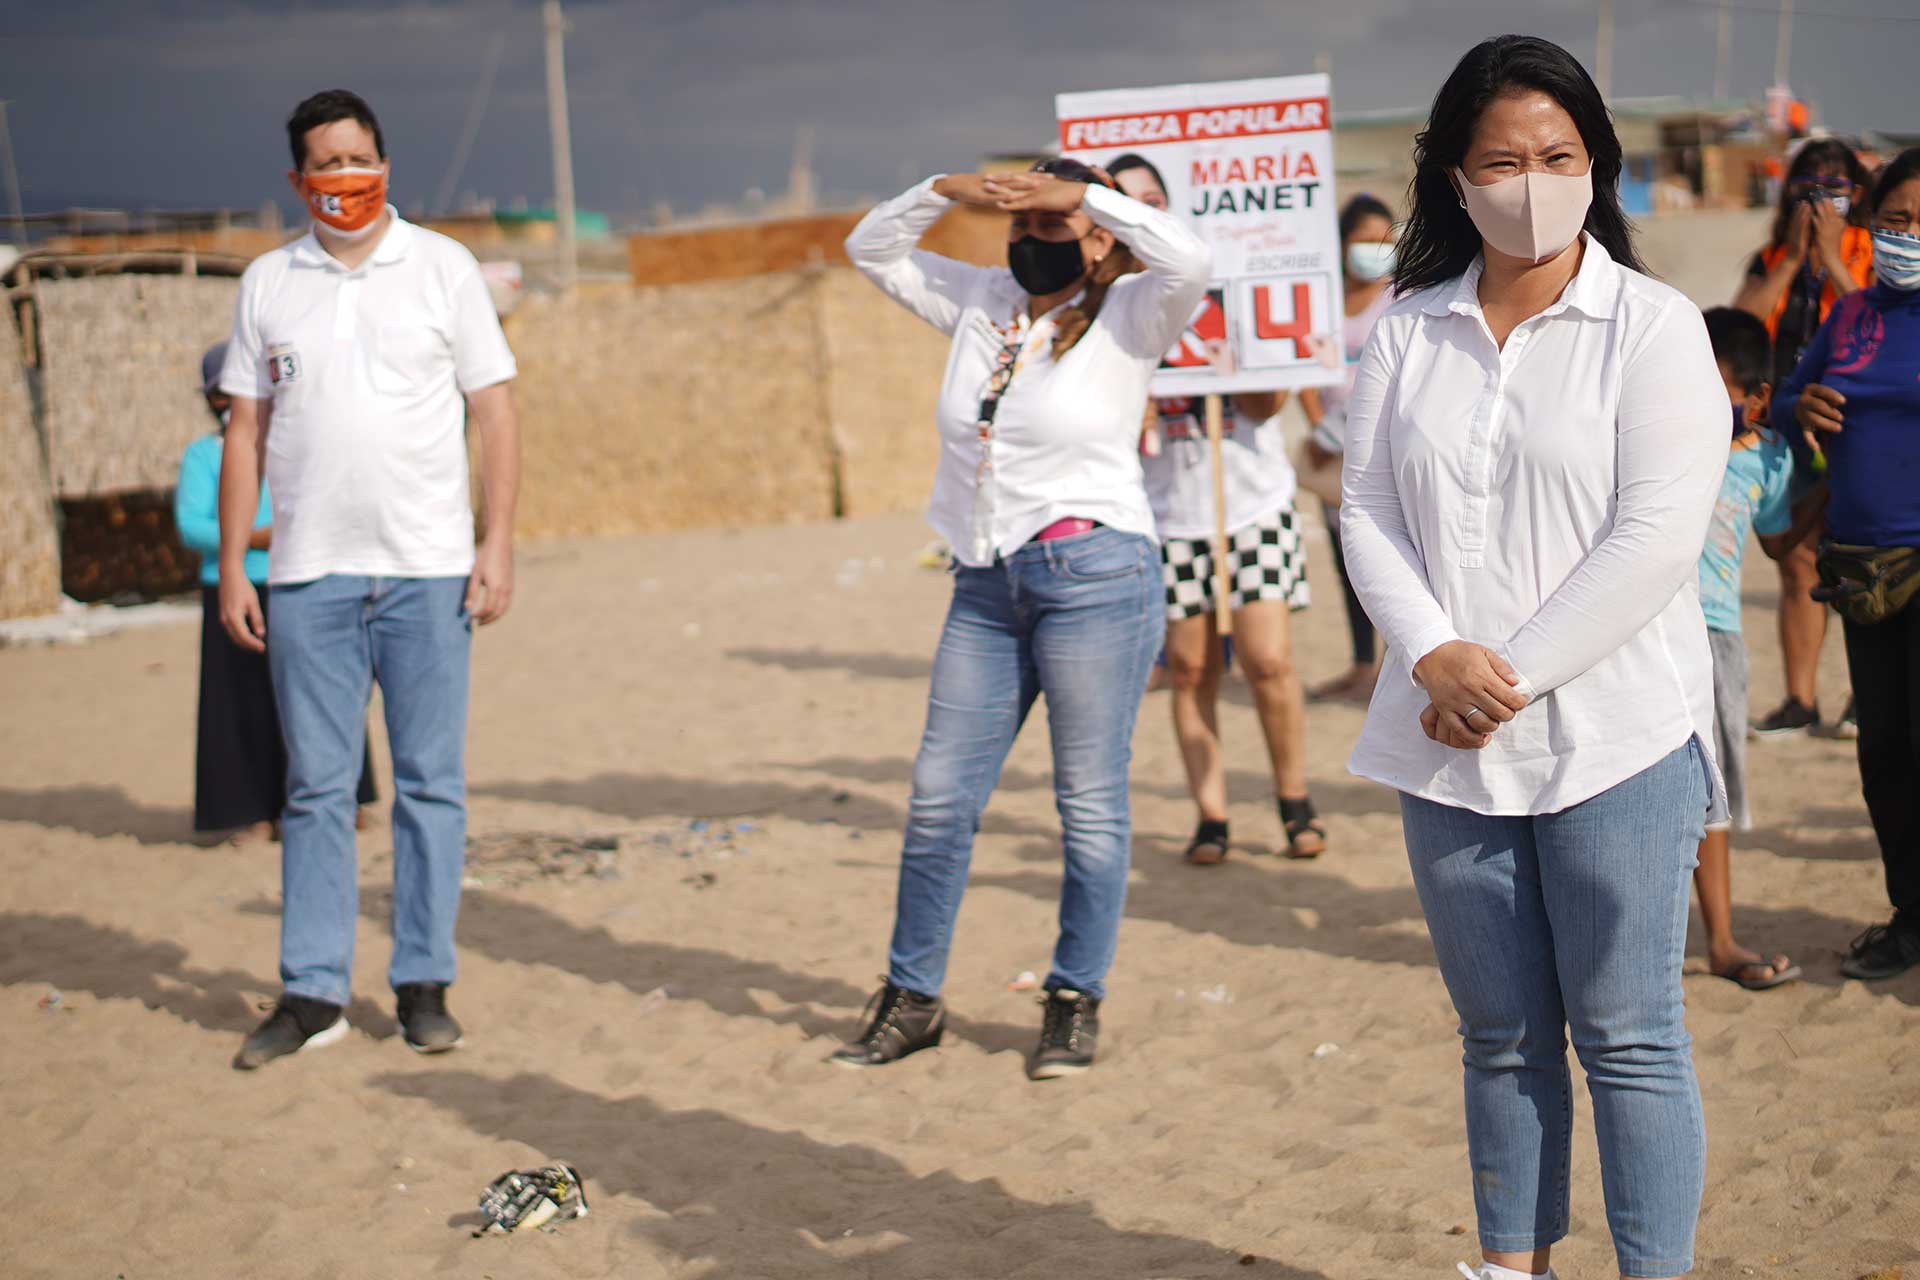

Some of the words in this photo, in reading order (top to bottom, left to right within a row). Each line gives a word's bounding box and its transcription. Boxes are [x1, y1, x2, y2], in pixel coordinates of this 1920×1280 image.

[1067, 115, 1183, 148] FUERZA
[1186, 102, 1323, 137] POPULAR
[1192, 148, 1318, 185] MARÍA
[1192, 182, 1320, 216] JANET
[1254, 283, 1313, 358] 4
